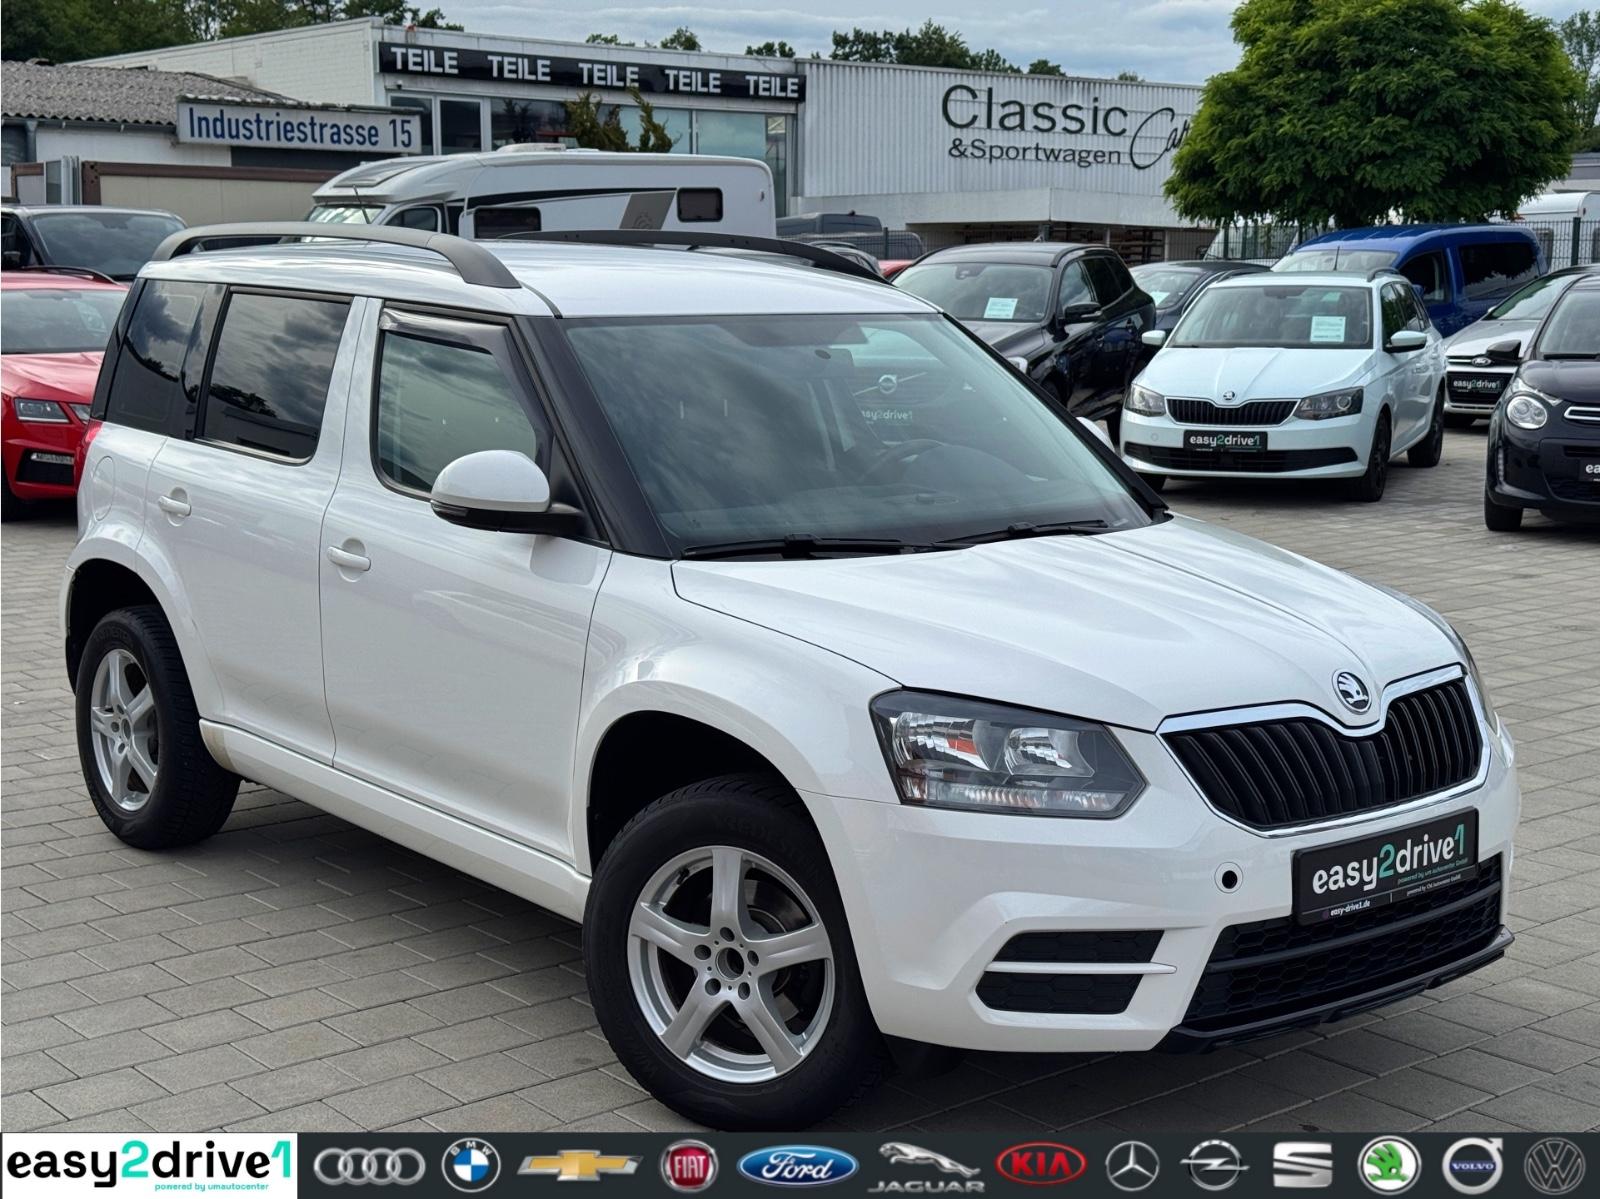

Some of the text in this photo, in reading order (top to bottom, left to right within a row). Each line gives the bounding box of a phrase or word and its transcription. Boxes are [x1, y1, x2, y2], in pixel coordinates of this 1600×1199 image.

[390, 46, 799, 98] TEILE TEILE TEILE TEILE TEILE
[188, 106, 412, 148] Industriestrasse 15
[942, 84, 1129, 138] Classic
[948, 137, 1122, 169] &Sportwagen
[1189, 434, 1260, 447] easy2drive1
[1312, 823, 1465, 892] easy2drive1
[1330, 900, 1371, 916] easy-drive1.de
